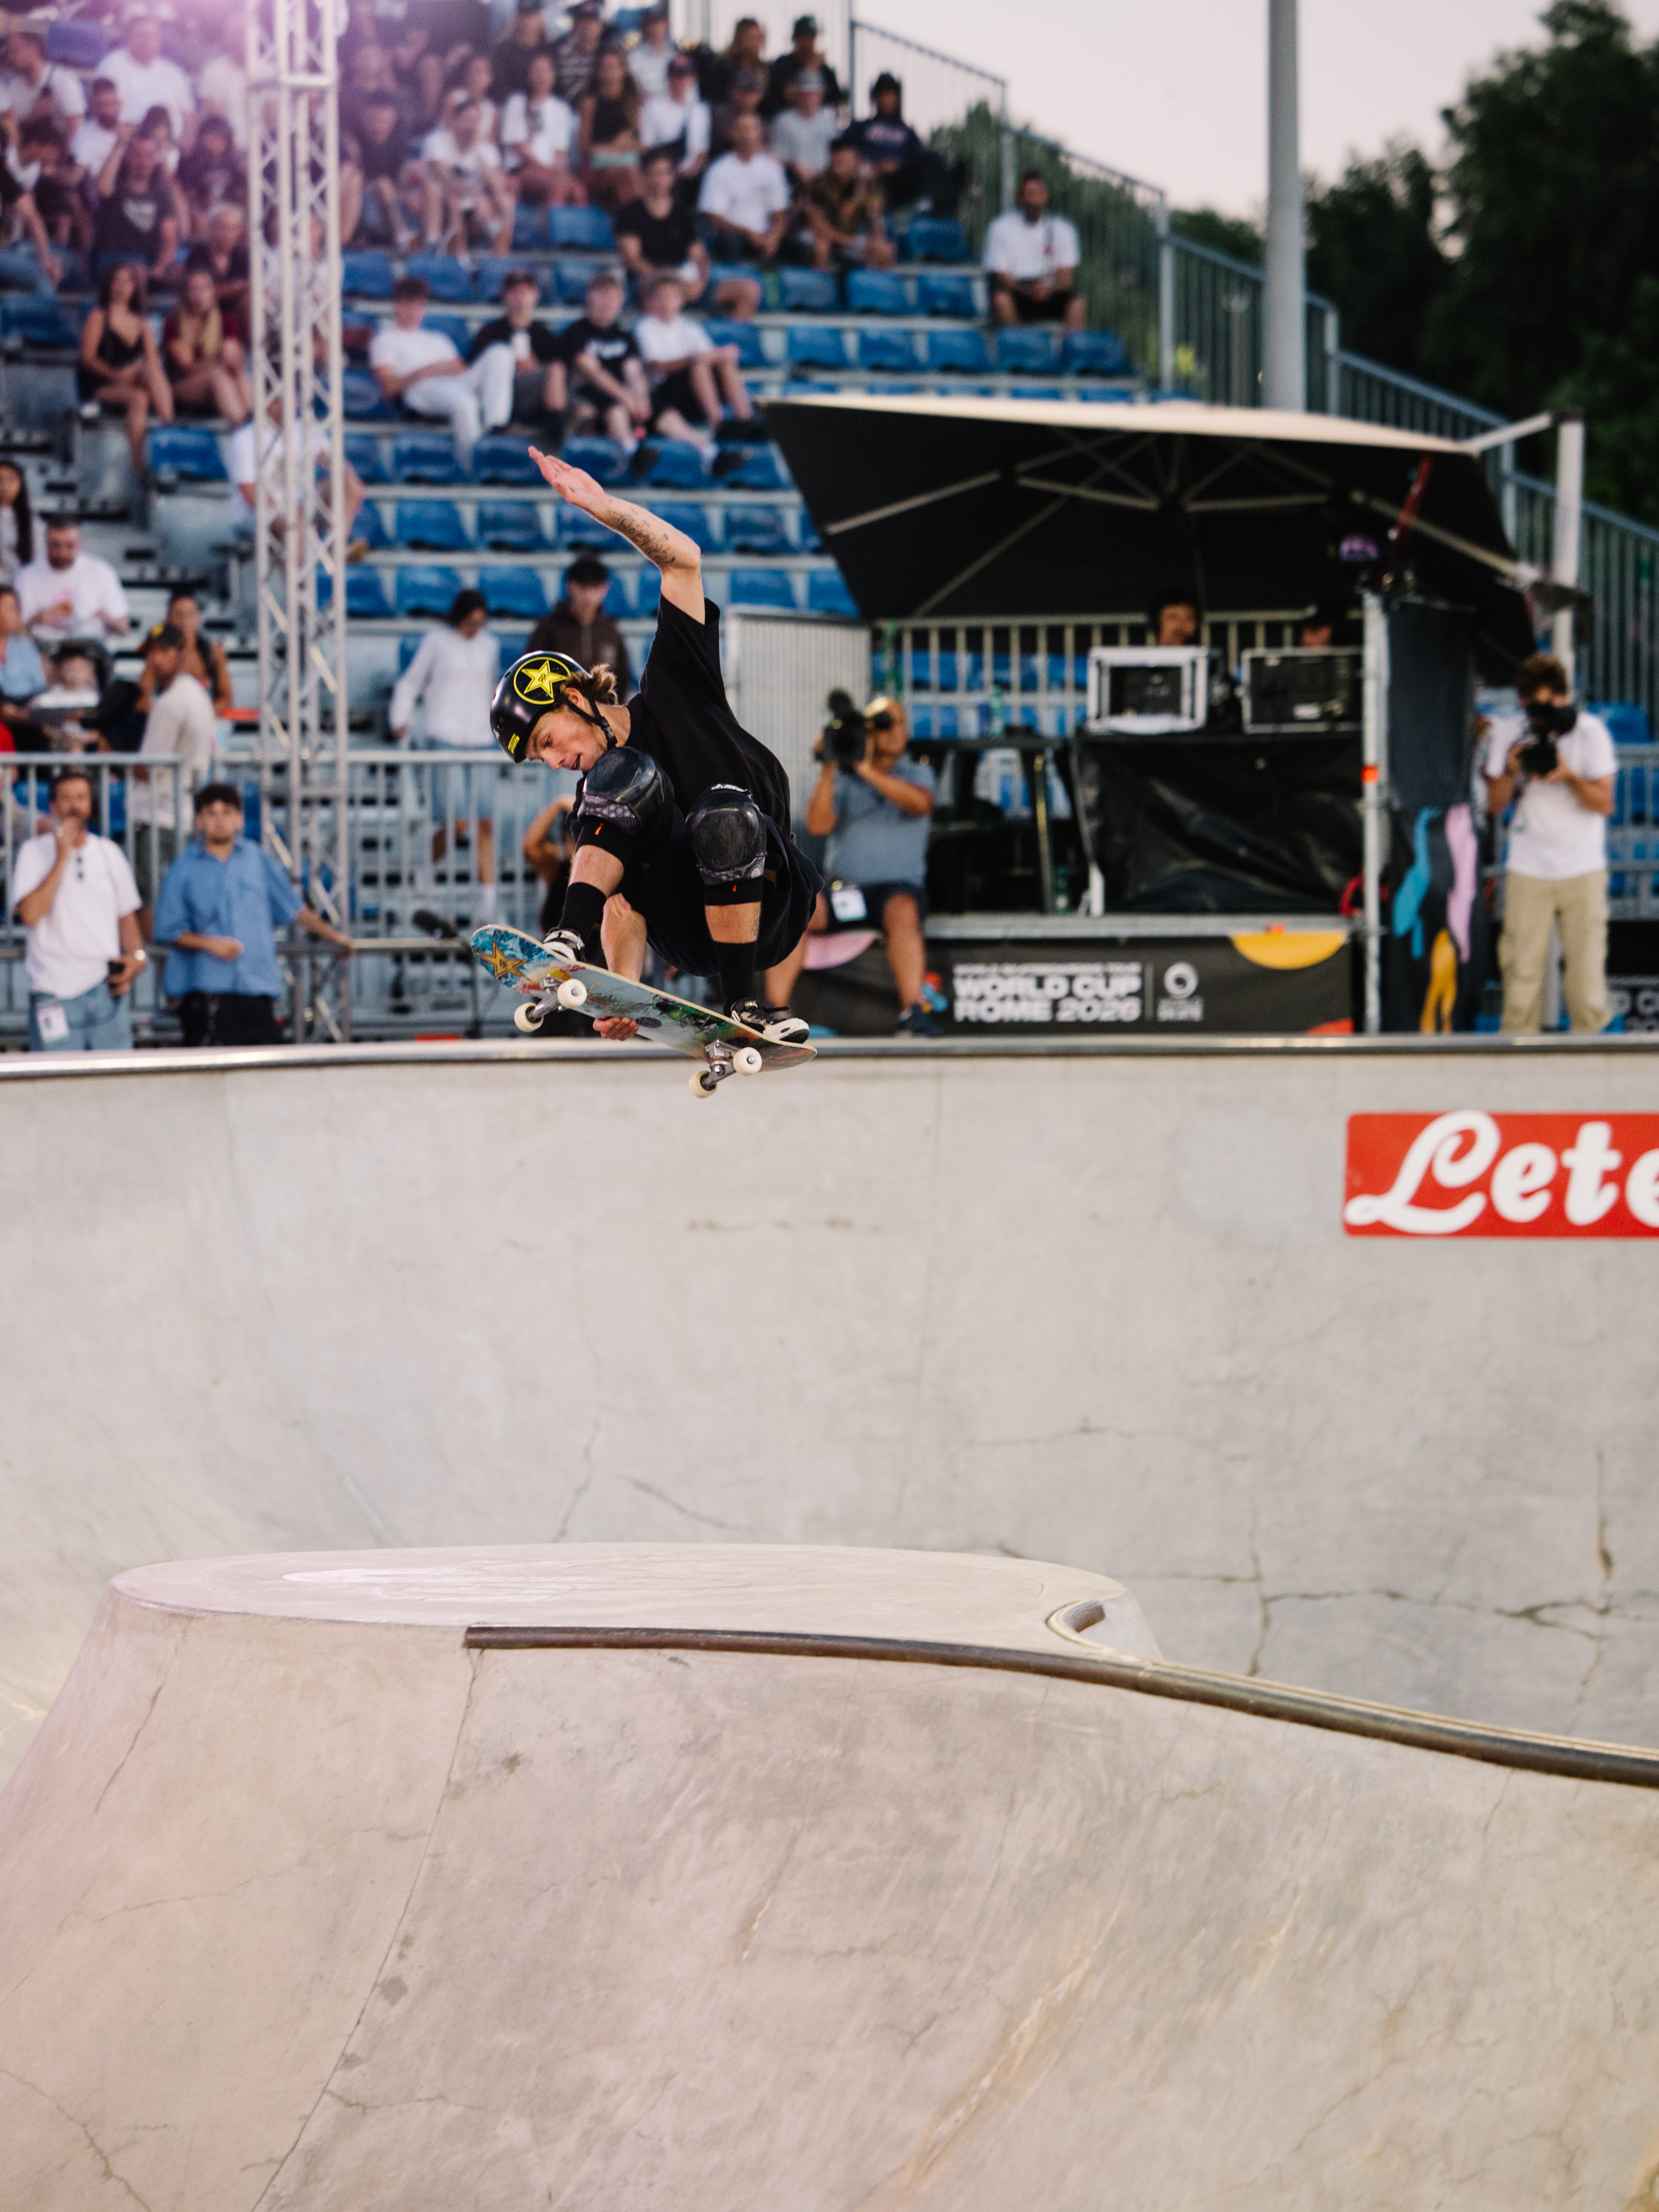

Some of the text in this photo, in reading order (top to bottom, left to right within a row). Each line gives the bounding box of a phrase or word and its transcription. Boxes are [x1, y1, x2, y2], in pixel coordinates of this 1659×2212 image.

[953, 975, 1141, 999] WORLD CUP
[954, 999, 1052, 1022] ROME
